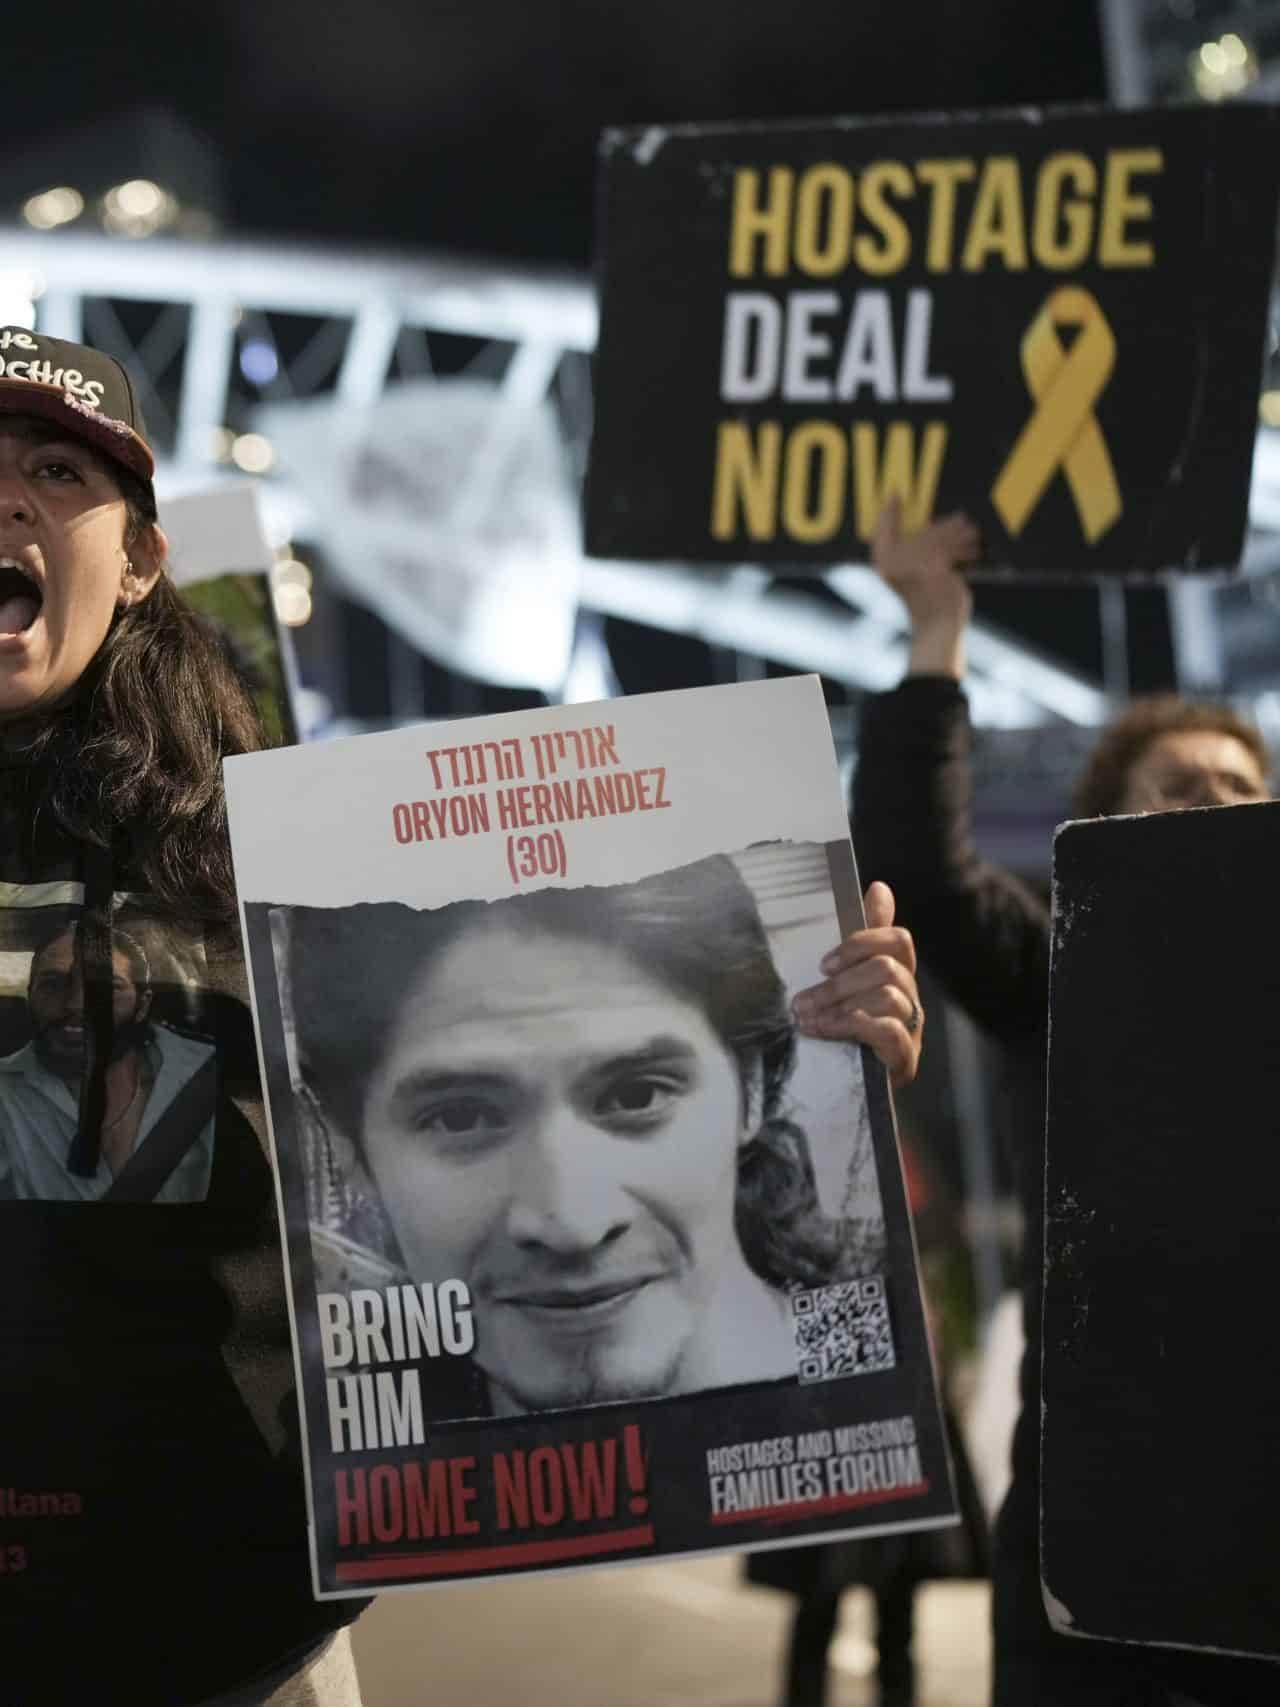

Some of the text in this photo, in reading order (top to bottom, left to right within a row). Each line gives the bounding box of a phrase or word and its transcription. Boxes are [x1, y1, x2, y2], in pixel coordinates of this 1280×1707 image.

[729, 148, 1163, 277] HOSTAGE
[721, 288, 953, 402] DEAL
[711, 420, 948, 541] NOW
[426, 725, 620, 790] אוריון הרננדז
[392, 767, 672, 844] ORYON HERNANDEZ
[507, 829, 567, 884] (30)
[317, 1278, 475, 1368] BRING
[326, 1369, 424, 1453] HIM
[706, 1416, 916, 1474] HOSTAGES AND MISSING
[335, 1424, 648, 1546] HOME NOW!
[710, 1445, 922, 1515] FAMILIES FORUM
